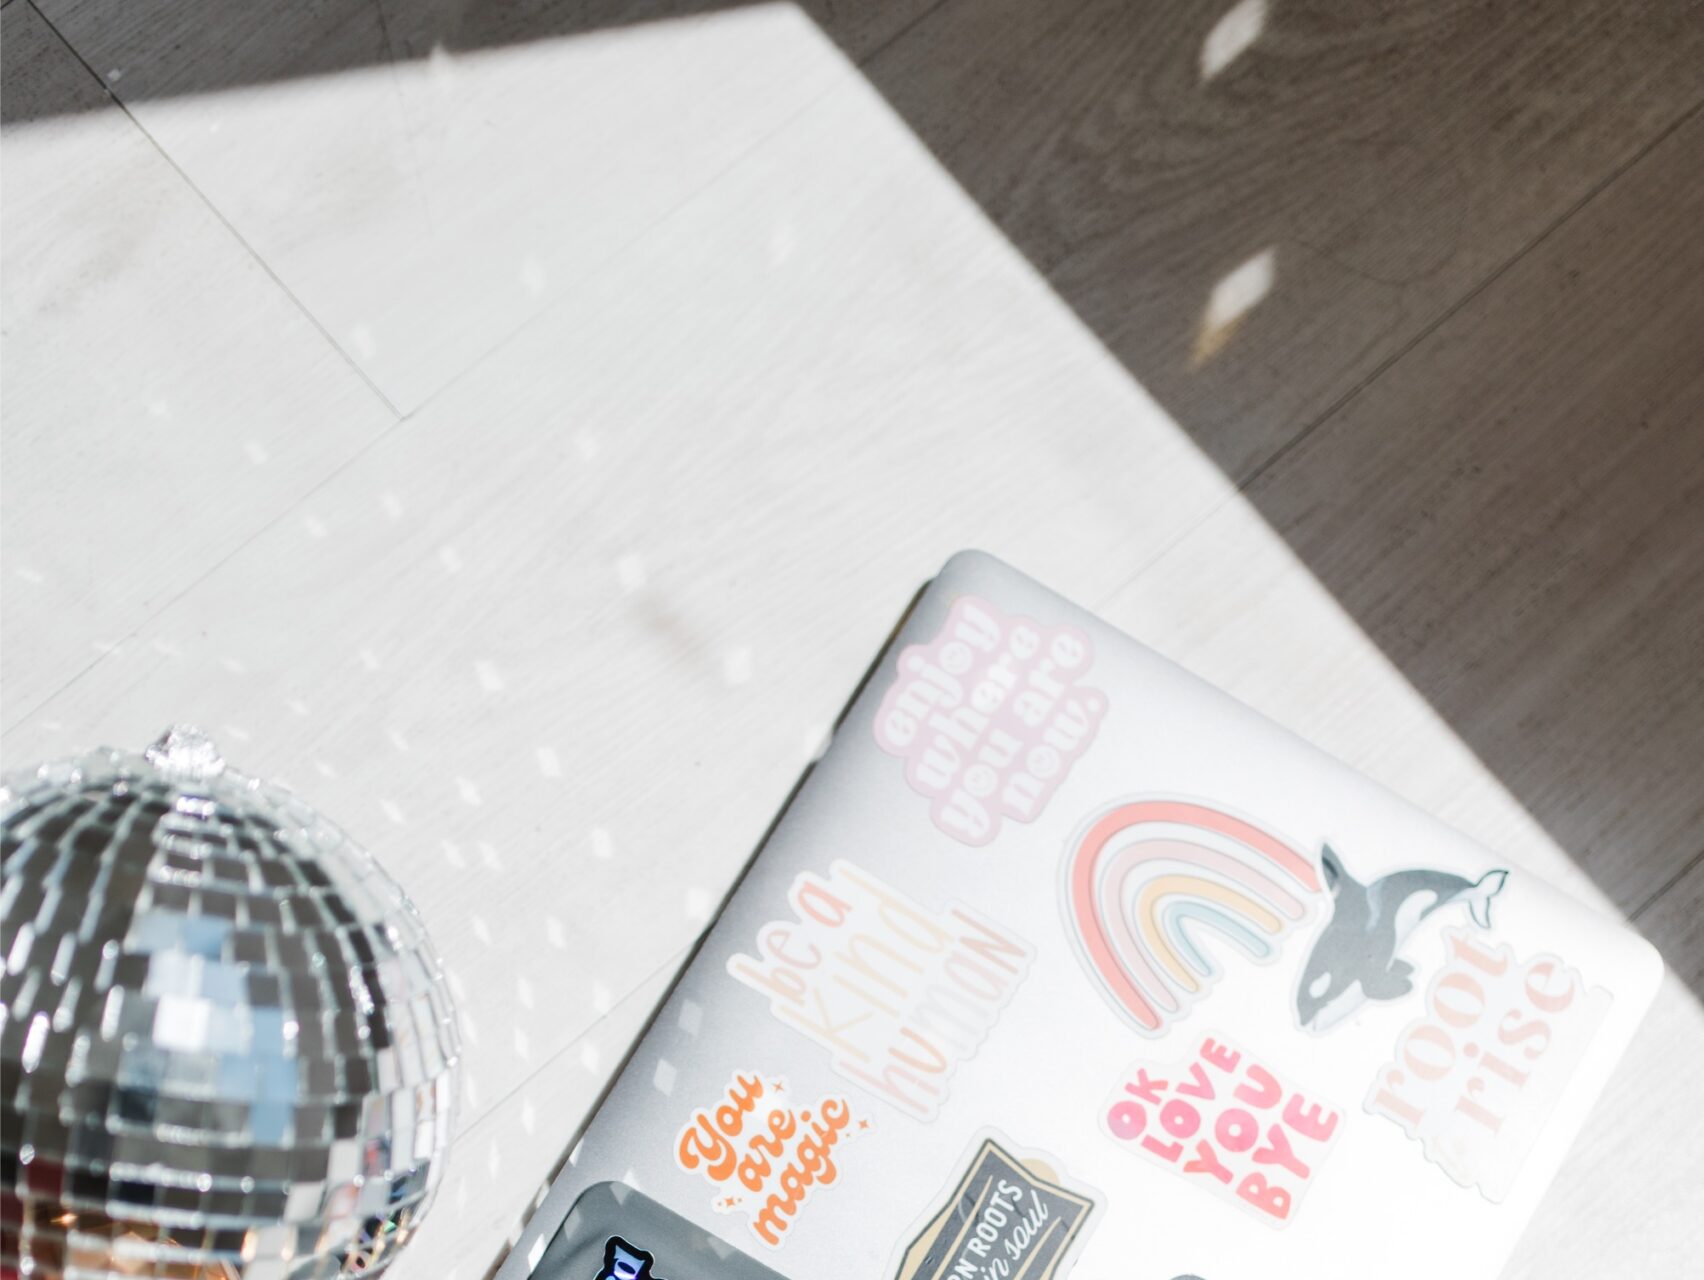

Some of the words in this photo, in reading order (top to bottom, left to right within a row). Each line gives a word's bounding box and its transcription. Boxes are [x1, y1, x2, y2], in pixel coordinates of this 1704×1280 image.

[884, 601, 1000, 747] enjoy
[916, 624, 1041, 790] where
[940, 728, 1025, 838] you
[1012, 632, 1085, 727] are
[736, 928, 822, 1007] be
[797, 881, 853, 928] a
[1375, 934, 1509, 1129] root
[1454, 961, 1576, 1138] rise
[679, 1075, 764, 1181] You
[738, 1109, 797, 1192] are
[1107, 1067, 1169, 1140] OK
[1141, 1037, 1242, 1163] LOVE
[1183, 1063, 1282, 1185] YOU
[1235, 1093, 1339, 1220] BYE
[753, 1099, 850, 1246] magic
[968, 1179, 1023, 1259] ROOTS
[1003, 1189, 1049, 1260] soul
